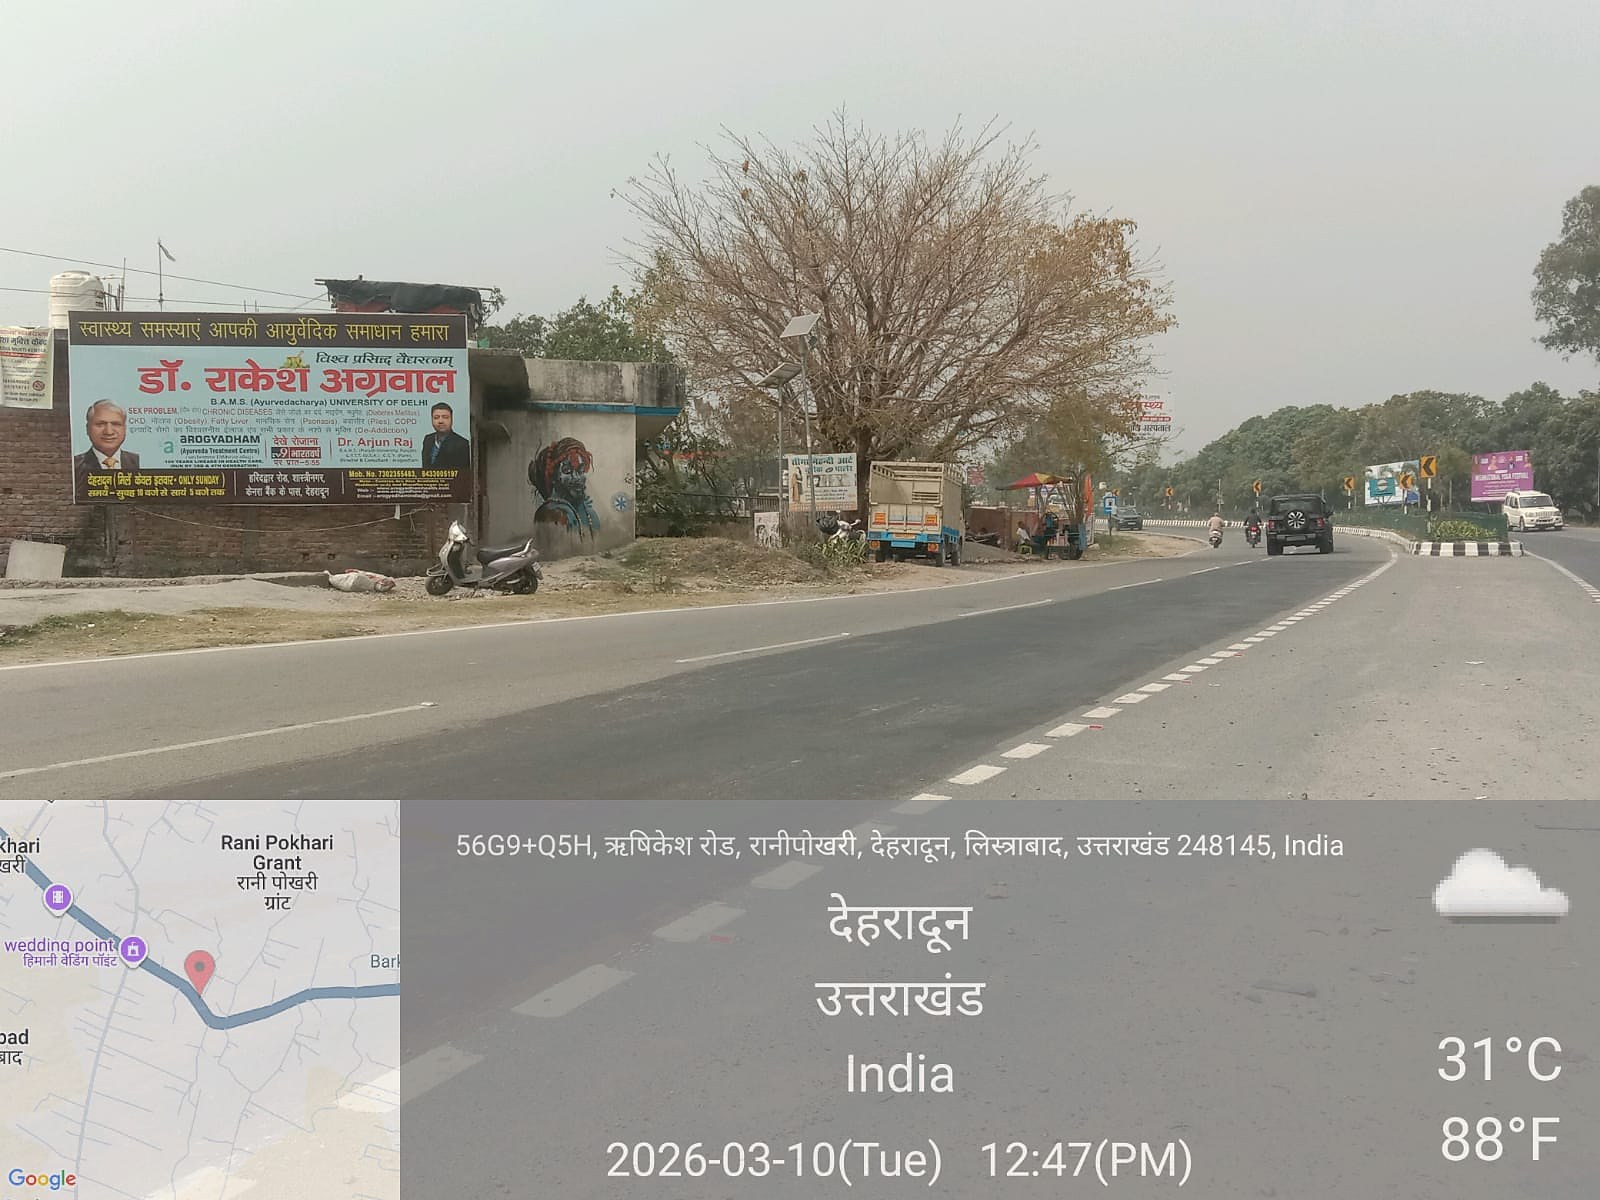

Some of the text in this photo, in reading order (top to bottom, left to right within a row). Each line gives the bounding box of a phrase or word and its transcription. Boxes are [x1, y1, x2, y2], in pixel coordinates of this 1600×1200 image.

[79, 318, 450, 345] स्वास्थ्य समस्याएं आपकी आयुर्वेदिक समाधान हमारा
[316, 352, 348, 364] विश्व
[138, 358, 457, 399] डॉ. राकेश अग्रवाल
[250, 398, 327, 408] (Ayurvedacharya)
[128, 407, 143, 415] SEX
[202, 408, 236, 416] CHRONIC
[237, 408, 273, 416] DISEASES
[128, 417, 146, 425] CKD
[211, 417, 230, 426] Fatty
[231, 417, 249, 425] Liver
[337, 437, 413, 449] Dr. Arjun Raj
[291, 447, 320, 458] भारतवर्ष
[134, 472, 152, 486] केवल
[348, 470, 365, 478] Mob.
[366, 470, 378, 478] No.
[178, 475, 195, 485] ONLY
[195, 475, 220, 485] SUNDAY
[278, 485, 286, 497] के
[304, 484, 330, 500] देहरादून
